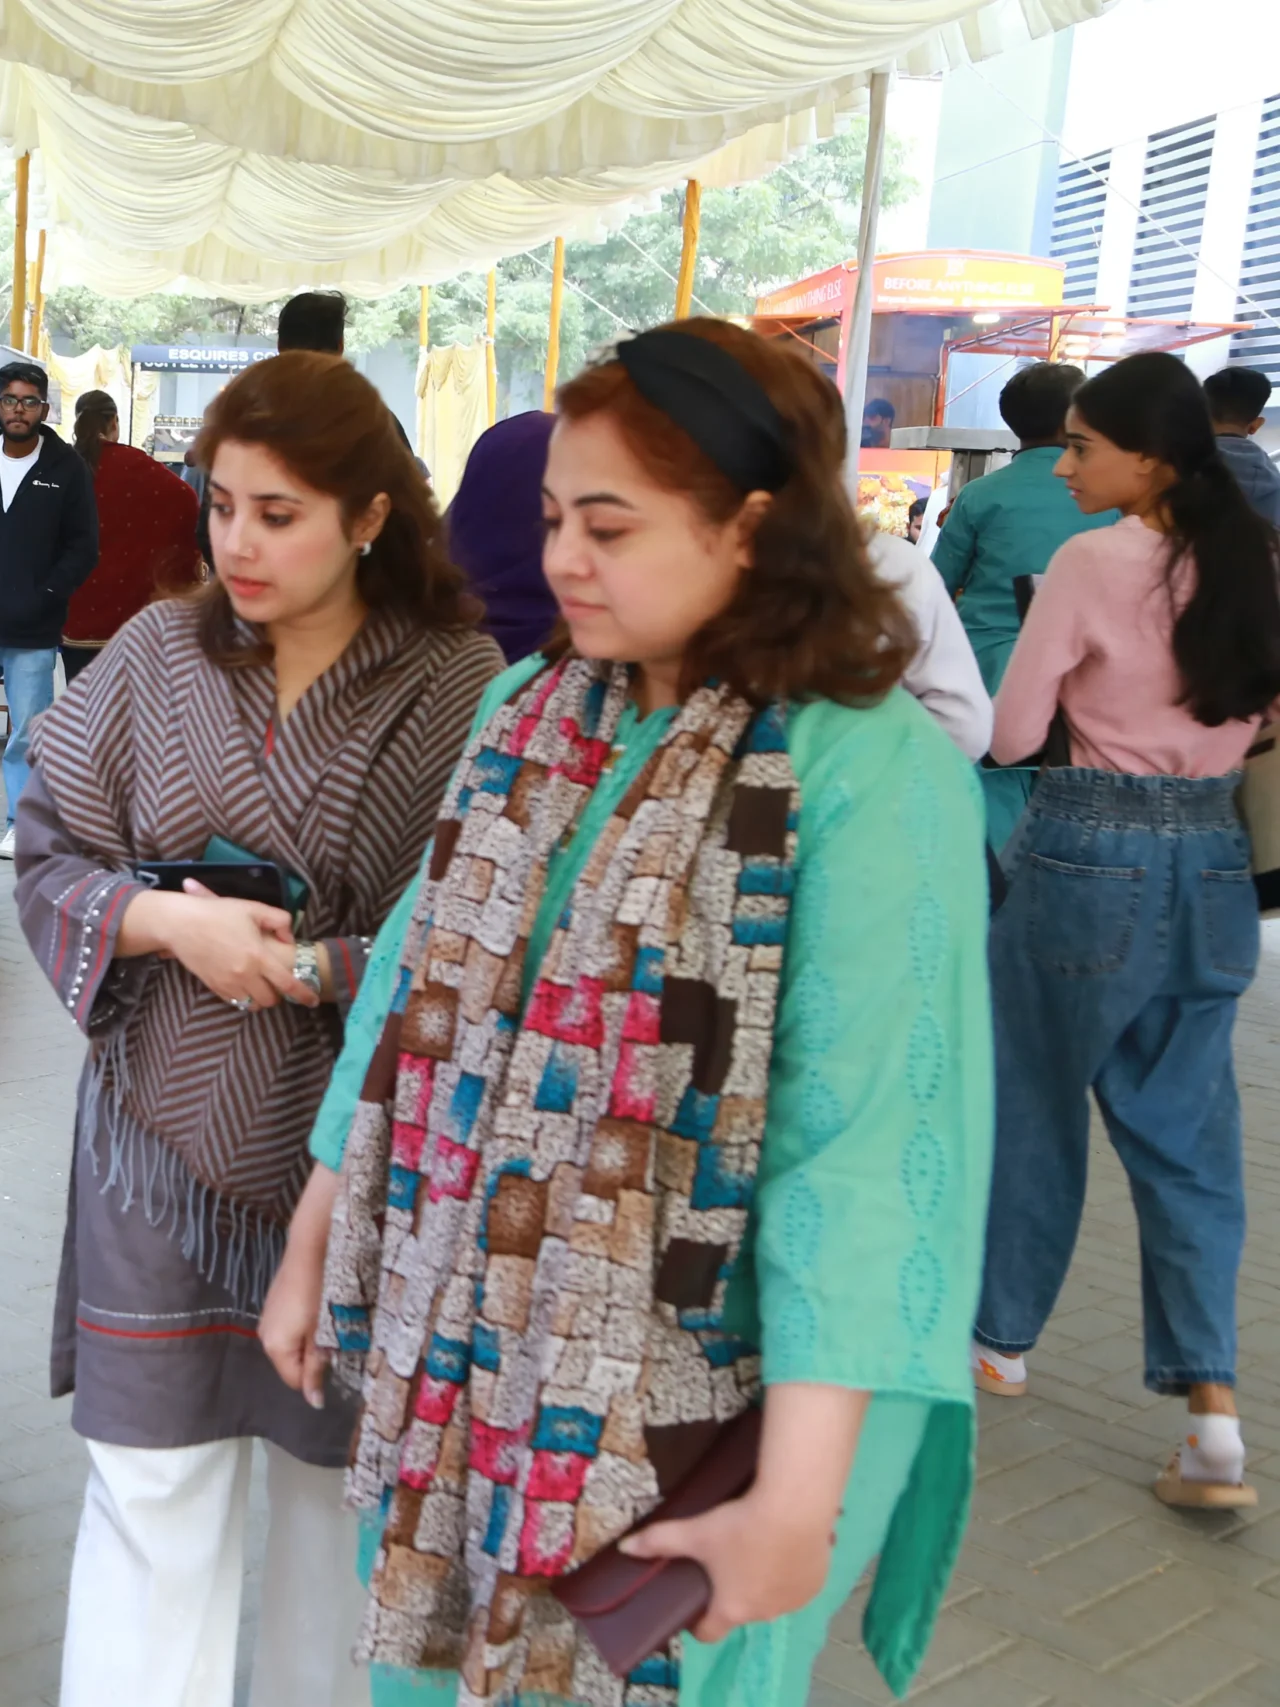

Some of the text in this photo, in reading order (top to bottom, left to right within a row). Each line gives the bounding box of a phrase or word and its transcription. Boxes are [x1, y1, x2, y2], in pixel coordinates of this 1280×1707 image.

[883, 277, 1035, 296] BEFORE ANYTHING ELSE
[168, 348, 281, 362] ESQUIRES CO
